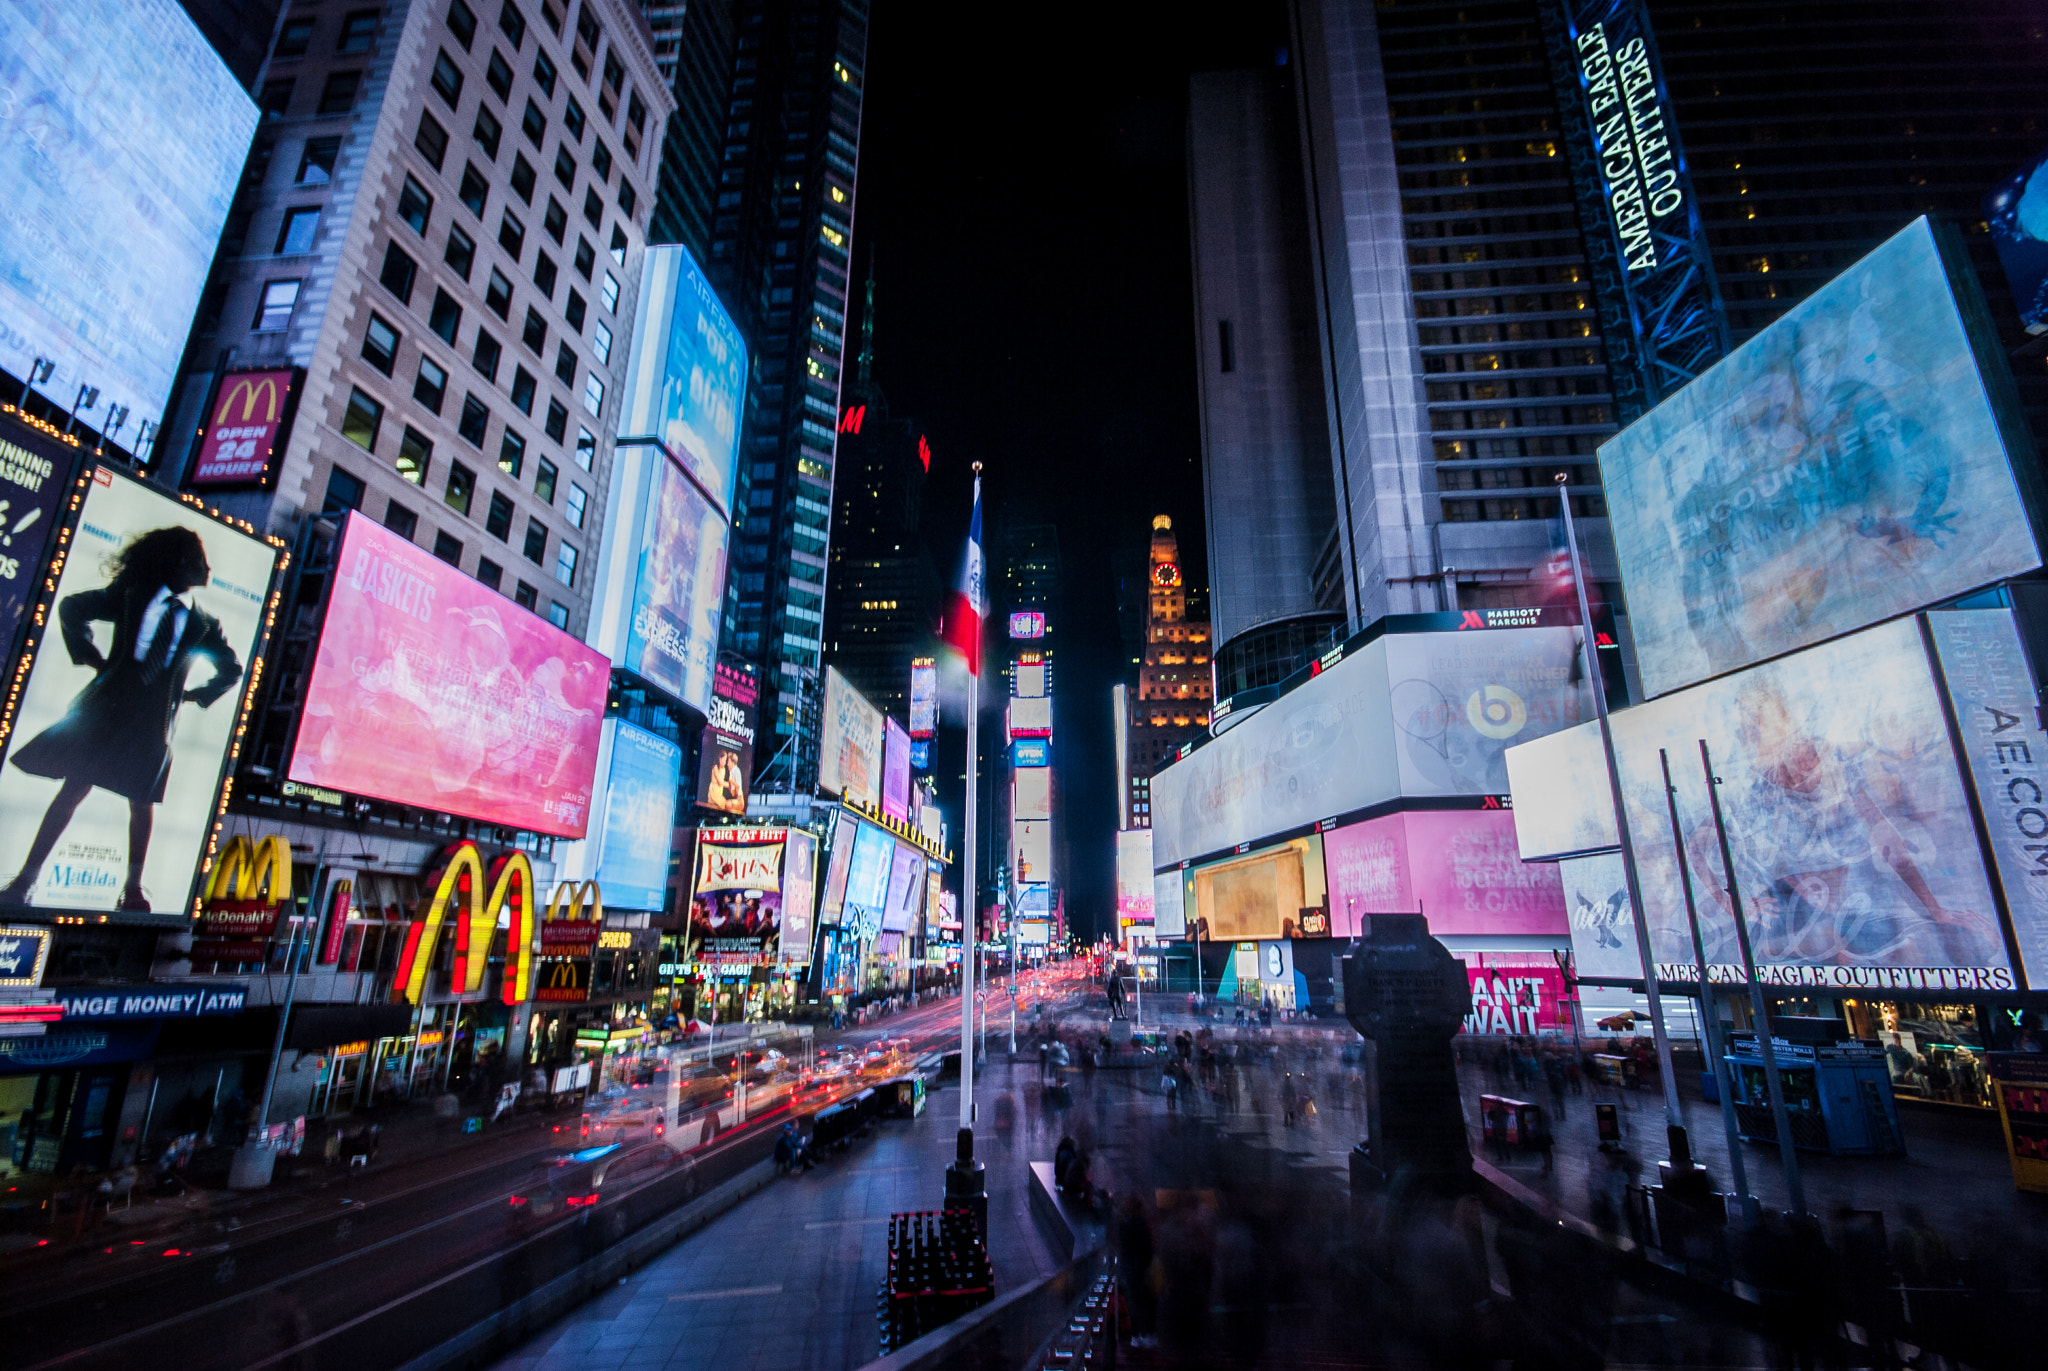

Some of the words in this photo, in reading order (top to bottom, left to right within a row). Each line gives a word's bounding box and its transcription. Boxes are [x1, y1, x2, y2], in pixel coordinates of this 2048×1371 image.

[1577, 22, 1621, 118] EAGLE
[1615, 37, 1682, 217] OUTFITTERS
[1596, 111, 1657, 271] AMERICAN
[216, 426, 267, 440] OPEN
[215, 440, 257, 461] 24
[199, 461, 264, 476] HOURS
[350, 547, 437, 624] BASKETS
[1487, 608, 1542, 619] MARRIOTT
[1488, 617, 1538, 627] MARQUIS
[1320, 644, 1344, 664] MARRIOTT
[1321, 653, 1343, 671] MARQUIS
[620, 726, 670, 756] AIRFRANCE
[561, 792, 577, 802] JAN
[737, 829, 758, 841] FAT
[46, 863, 117, 888] Matilda
[706, 850, 780, 883] ROTTEN!
[202, 910, 274, 924] McDonald's
[543, 926, 597, 936] McDonald's
[1655, 963, 1749, 983] MERCAN
[1754, 966, 1828, 987] EAGLE
[1833, 966, 2013, 991] OUTFITTERS
[205, 992, 244, 1011] ATM
[1471, 977, 1544, 1008] AN'T
[123, 994, 197, 1015] MONEY
[1794, 1047, 1813, 1055] ROLLS
[1835, 1040, 1865, 1049] SnackBox
